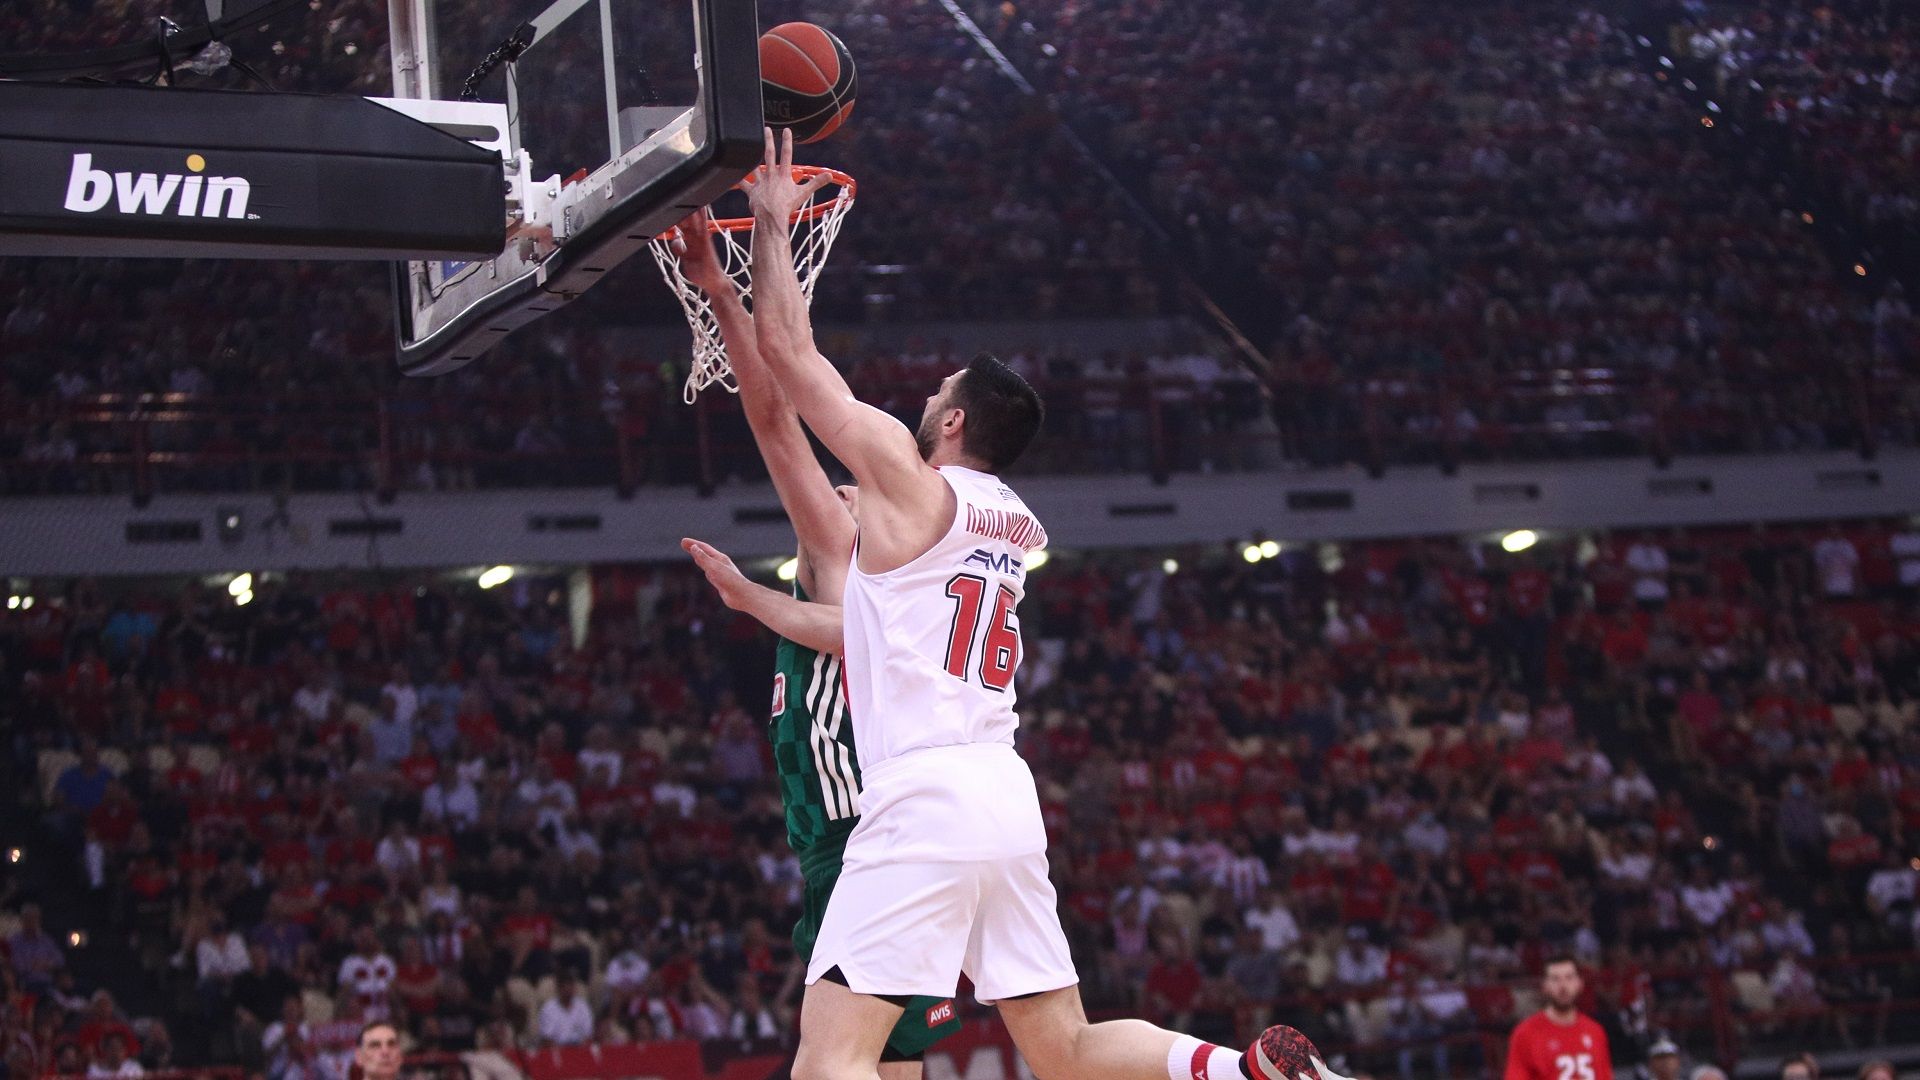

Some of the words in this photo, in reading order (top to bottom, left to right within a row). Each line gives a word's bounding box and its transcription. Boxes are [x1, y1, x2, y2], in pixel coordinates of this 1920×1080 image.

[64, 153, 250, 219] bwin
[944, 573, 1019, 693] 16
[930, 1004, 951, 1024] AVIS
[1555, 1054, 1595, 1080] 25
